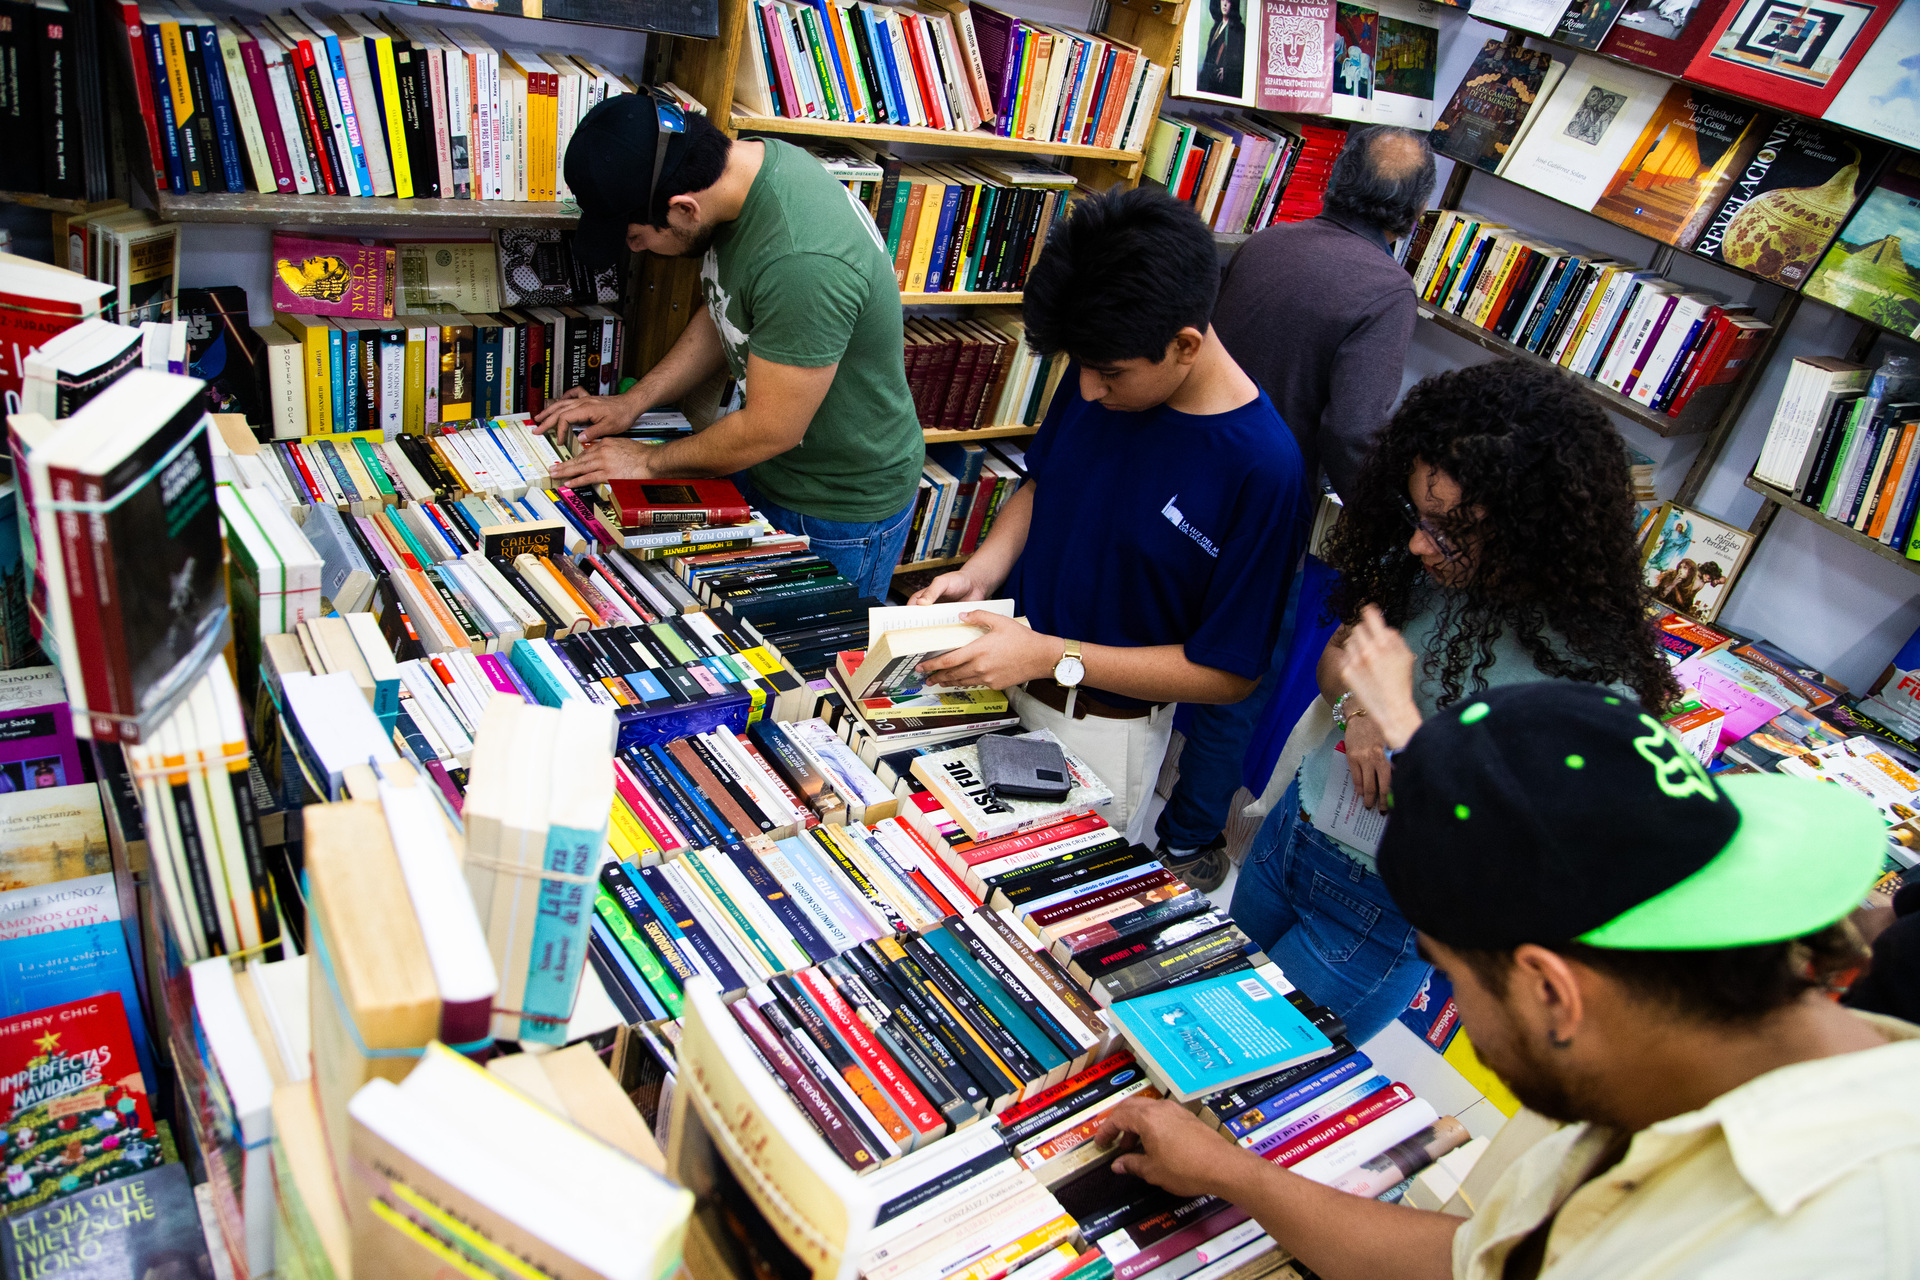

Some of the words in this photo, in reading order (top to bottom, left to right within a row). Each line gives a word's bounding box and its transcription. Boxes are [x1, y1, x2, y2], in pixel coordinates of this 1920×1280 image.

[1266, 3, 1293, 15] PARA
[308, 68, 319, 89] NADA
[1475, 84, 1488, 93] LOS
[313, 89, 324, 109] SUPO
[336, 76, 353, 115] BIZARRO
[1468, 88, 1479, 97] DE
[1478, 92, 1487, 100] LA
[318, 108, 329, 129] NADIE
[1683, 97, 1700, 111] San
[1699, 102, 1735, 123] Cristóbal
[1733, 114, 1745, 126] de
[1688, 110, 1704, 124] Las
[1703, 115, 1727, 131] Casas
[345, 115, 360, 147] MÉXICO
[1794, 126, 1808, 137] del
[1793, 135, 1826, 154] popular
[1803, 148, 1837, 163] mexicano
[1695, 112, 1799, 259] REVELACIONES
[358, 250, 365, 262] DE
[367, 251, 375, 265] LAS
[351, 263, 367, 312] CÉSAR
[365, 266, 377, 312] MUJERES
[365, 340, 374, 370] LANGOSTA
[485, 351, 495, 381] QUEEN
[366, 388, 374, 400] AÑO
[500, 533, 551, 548] CARLOS
[631, 537, 663, 546] BORGIA
[692, 532, 715, 542] PUZO
[716, 528, 744, 538] MARIO
[1180, 519, 1191, 529] LA
[1188, 525, 1203, 538] LUZ
[1200, 535, 1214, 548] DEL
[1713, 533, 1742, 551] Paraíso
[1723, 530, 1735, 541] El
[662, 546, 696, 555] ELEFANTE
[697, 543, 724, 551] HOMBRE
[1701, 535, 1731, 553] Perdido
[1694, 623, 1726, 641] Stephen
[1745, 648, 1780, 671] COCINA
[1776, 668, 1824, 700] MEXICANA
[9, 717, 36, 727] Sacks
[1835, 703, 1920, 752] POSTRES
[752, 749, 773, 774] SUCIA
[783, 747, 792, 757] DE
[768, 768, 789, 793] ARENA
[798, 765, 809, 778] LOS
[943, 758, 978, 788] FUE
[784, 788, 796, 801] LA
[25, 808, 81, 823] esperanzas
[1003, 847, 1041, 868] TATIANA
[1048, 840, 1071, 853] MARTIN
[1071, 835, 1087, 846] CRUZ
[1087, 830, 1106, 842] SMITH
[614, 881, 638, 910] JORDAN
[626, 884, 642, 902] LEES
[791, 878, 815, 906] NEGROS
[811, 871, 840, 904] AFTER
[65, 903, 98, 916] CON
[781, 902, 799, 924] AYALA
[809, 899, 835, 931] MINUTOS
[690, 931, 708, 953] AYALA
[831, 925, 846, 942] LOS
[968, 933, 1005, 978] VIRTUALES
[1002, 968, 1033, 1006] AMORES
[58, 1004, 98, 1021] CHIC
[794, 992, 823, 1029] POMPEYA
[899, 1000, 920, 1026] CIUDAD
[1033, 1002, 1060, 1035] CASTAÑEDA
[917, 1022, 927, 1033] LA
[923, 1029, 934, 1041] DE
[930, 1036, 950, 1061] ÁNGEL
[1057, 1028, 1077, 1052] MARINA
[865, 1046, 878, 1059] LA
[946, 1057, 956, 1067] EL
[1, 1045, 112, 1094] IMPERFECTAS
[875, 1057, 897, 1083] YEBRA
[10, 1065, 105, 1107] NAVIDADES
[893, 1078, 918, 1109] VIRUCA
[1025, 1095, 1044, 1109] LUIS
[1044, 1081, 1069, 1100] SPOTA
[1073, 1066, 1099, 1085] MITAD
[1049, 1128, 1084, 1156] LINDSEY
